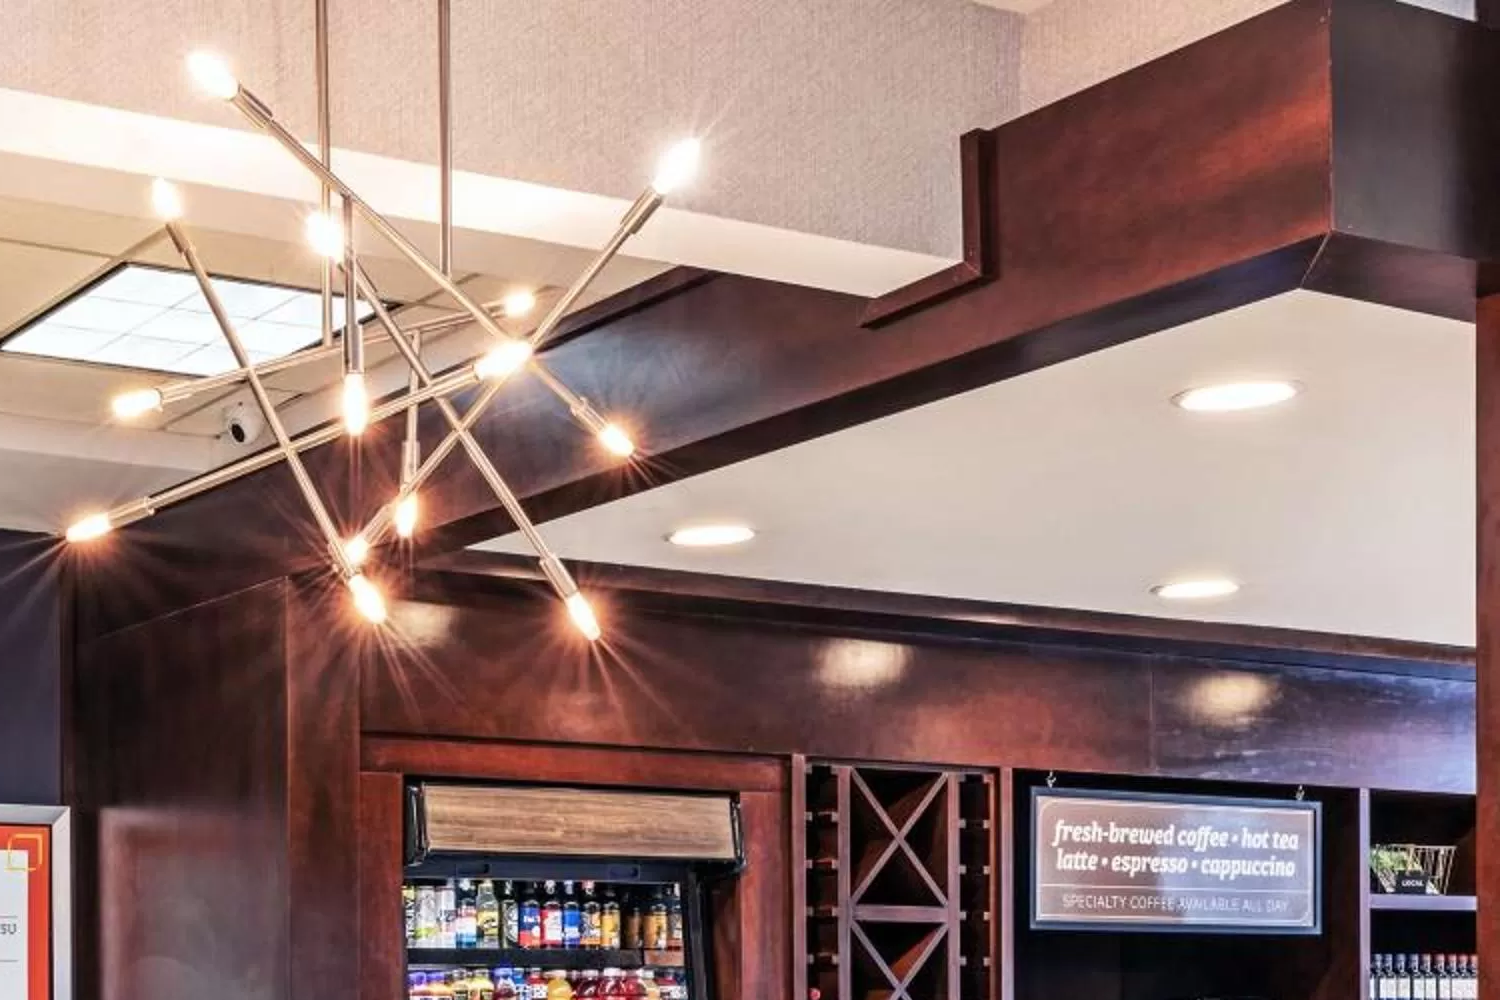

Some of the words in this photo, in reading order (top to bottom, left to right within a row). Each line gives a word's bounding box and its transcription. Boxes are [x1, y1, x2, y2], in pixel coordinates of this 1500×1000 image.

[1052, 820, 1174, 847] fresh-brewed
[1177, 825, 1228, 852] coffee
[1241, 828, 1270, 849] hot
[1273, 830, 1298, 850] tea
[1056, 849, 1097, 871] latte
[1111, 854, 1188, 877] espresso
[1201, 857, 1296, 880] cappuccino
[1401, 879, 1425, 887] LOCAL
[1062, 894, 1126, 909] SPECIALTY
[1131, 895, 1175, 911] COFFEE
[1177, 896, 1241, 912] AVAILABLE
[1243, 898, 1262, 913] ALL
[1266, 899, 1289, 914] DAY
[0, 923, 17, 935] SU
